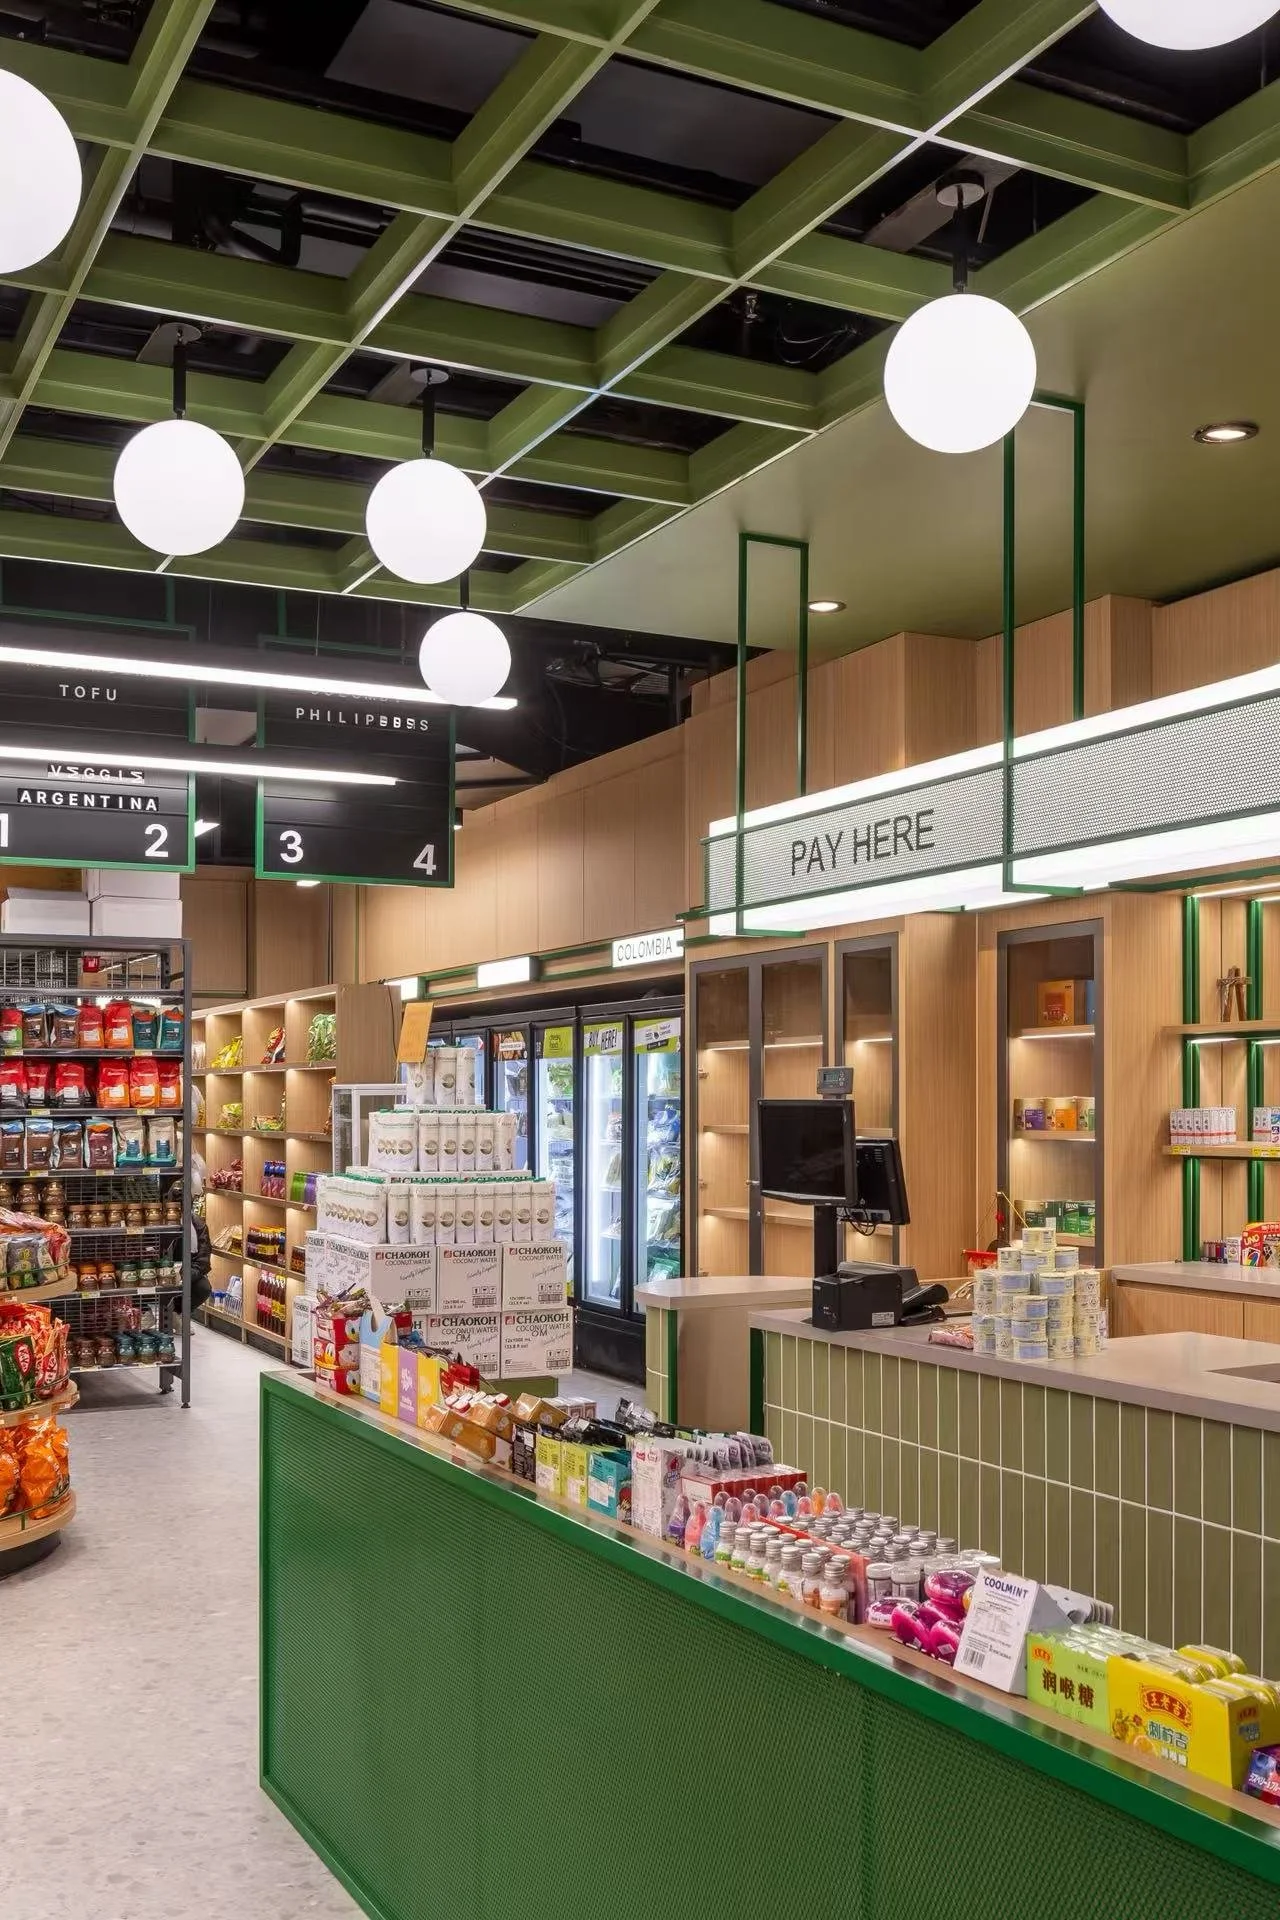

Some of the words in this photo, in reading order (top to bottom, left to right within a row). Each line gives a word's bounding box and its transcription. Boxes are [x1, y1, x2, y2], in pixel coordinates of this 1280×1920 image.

[59, 684, 117, 701] TOFU
[20, 790, 158, 811] ARGENTINA
[144, 823, 169, 858] 2
[279, 829, 304, 863] 3
[791, 830, 844, 876] PAY
[853, 808, 935, 864] HERE
[413, 843, 437, 876] 4
[617, 936, 673, 961] COLOMBIA
[1243, 1233, 1260, 1246] UNO
[385, 1251, 430, 1260] CHAOKOH
[451, 1249, 496, 1258] CHAOKOH
[518, 1246, 562, 1255] CHAOKOH
[441, 1316, 497, 1327] CHAOKOH
[516, 1313, 569, 1325] CHAOKOH
[547, 1322, 571, 1330] WATER
[477, 1326, 499, 1334] WATER
[984, 1576, 1029, 1599] COOLMINT
